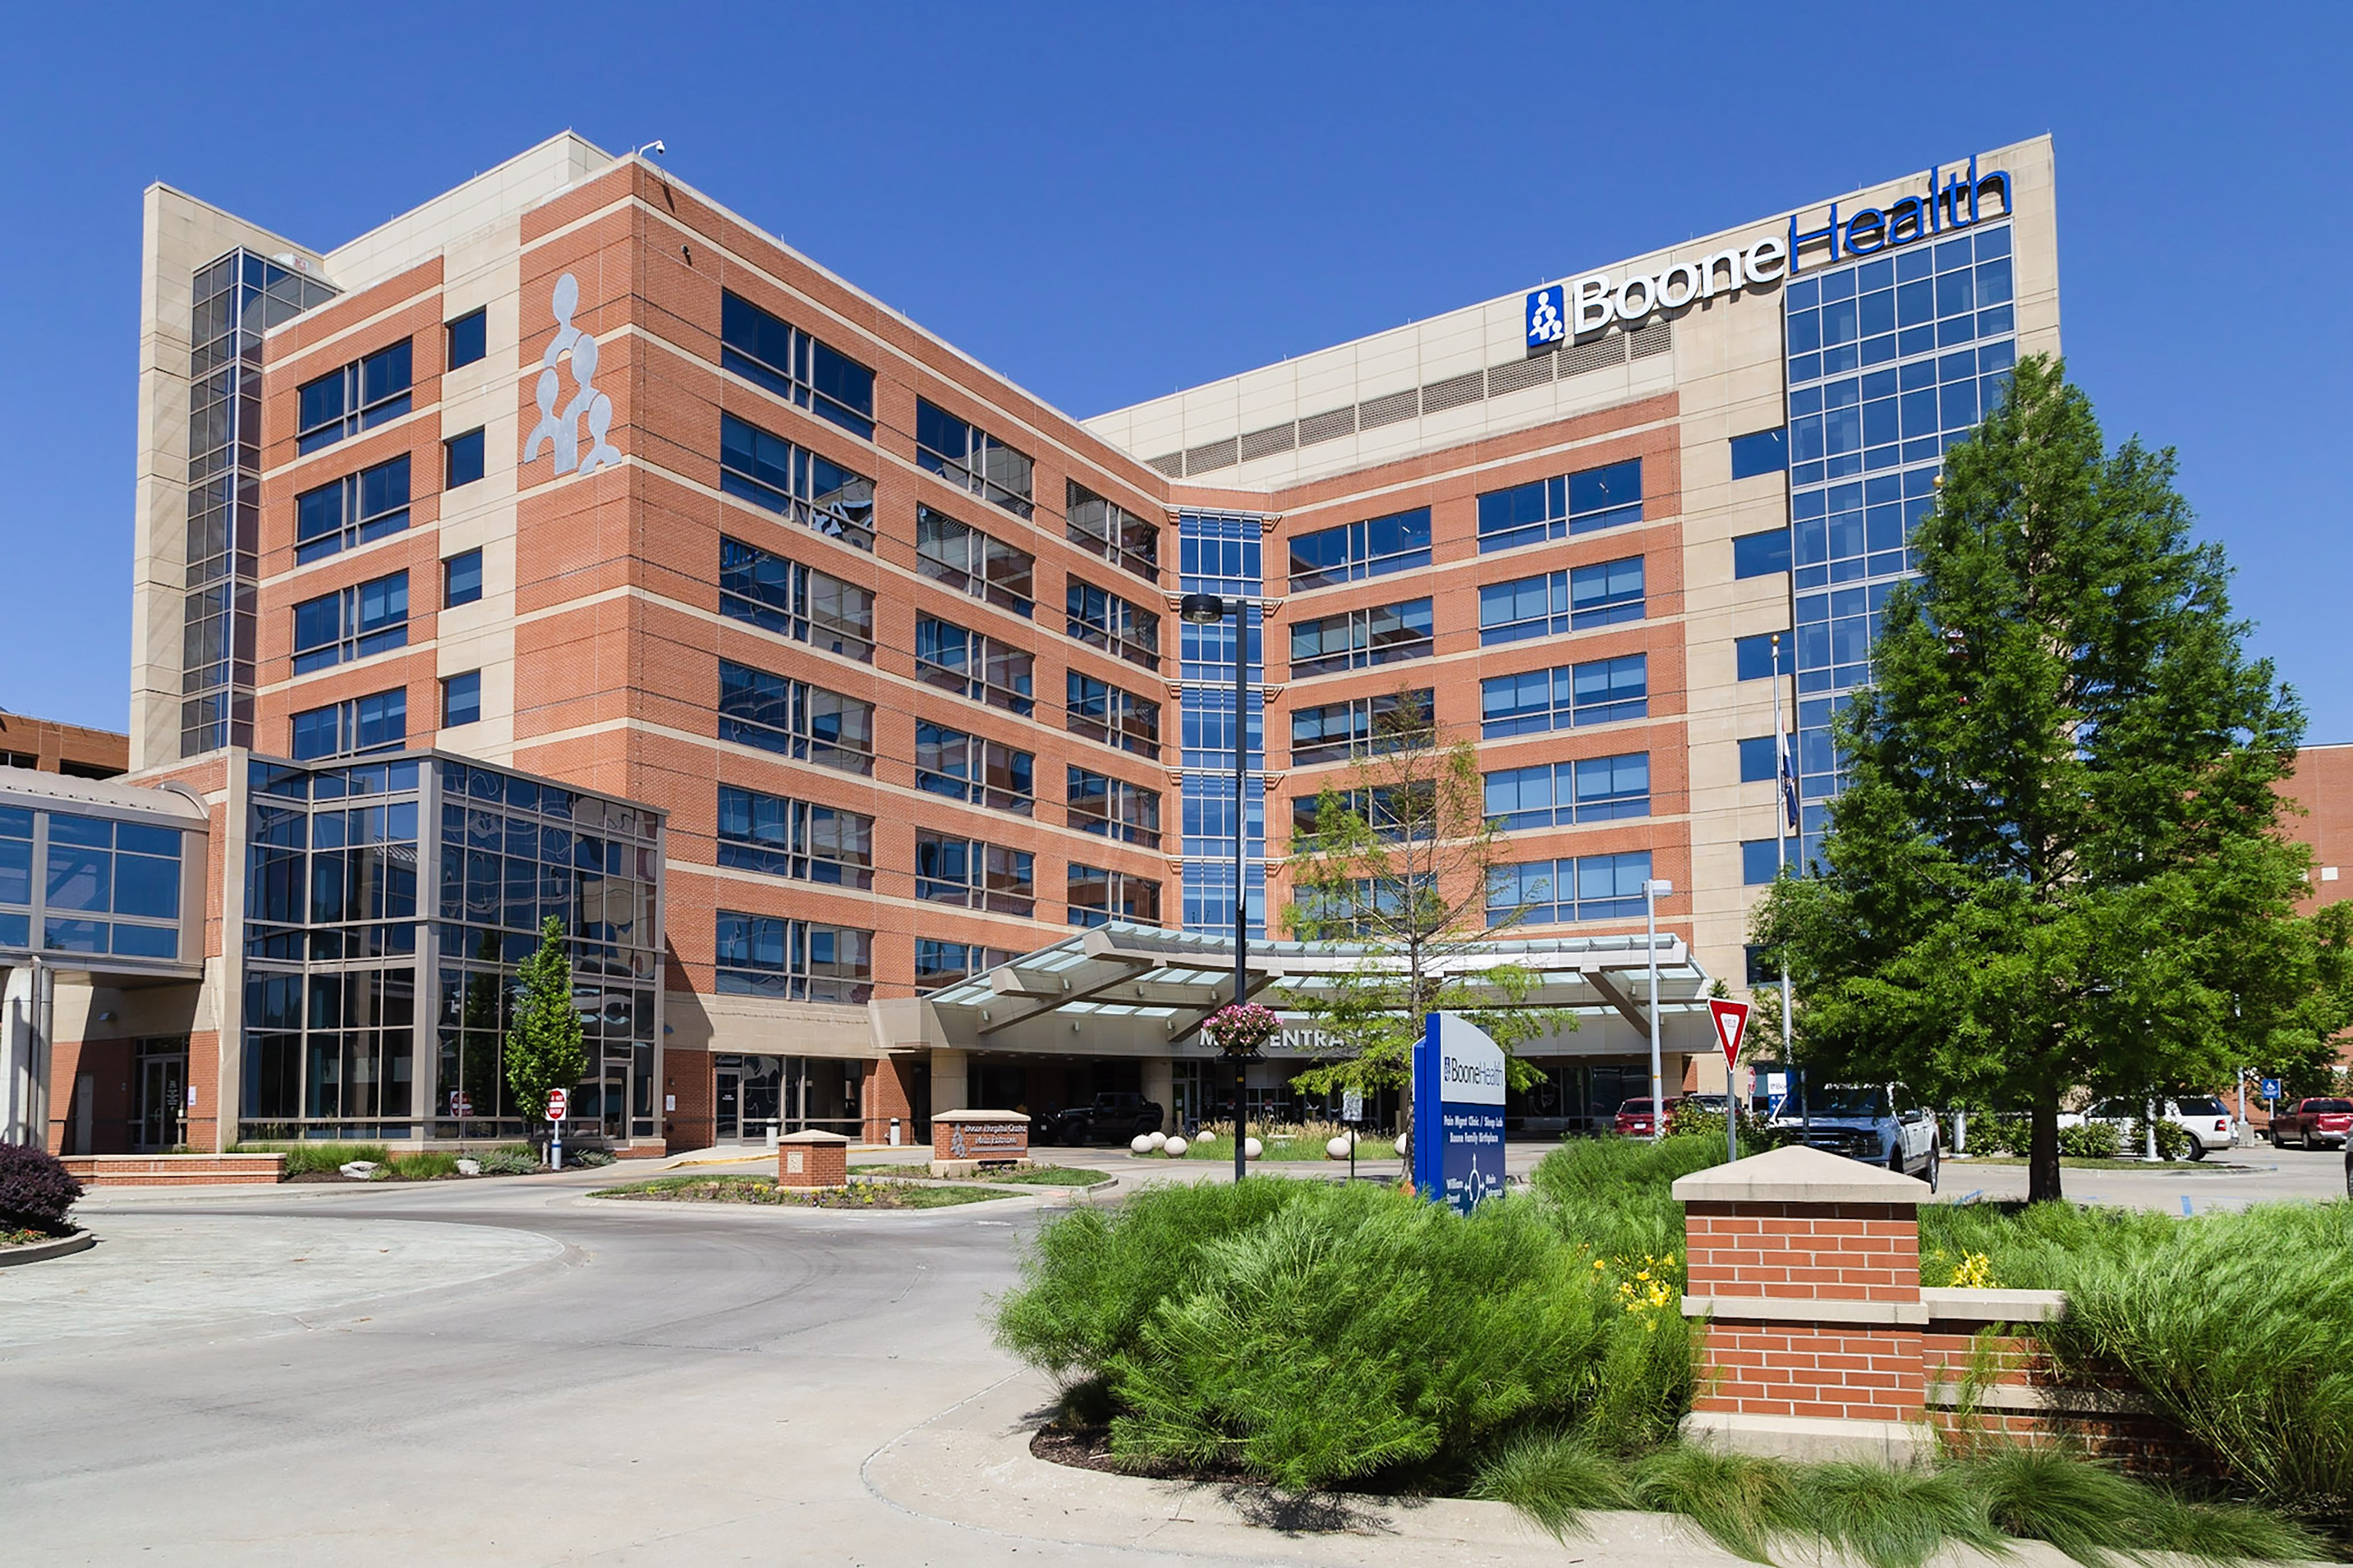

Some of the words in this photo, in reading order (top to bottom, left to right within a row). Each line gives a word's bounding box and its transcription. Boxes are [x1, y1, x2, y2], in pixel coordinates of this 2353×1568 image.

[1572, 154, 2012, 335] BooneHealth
[1451, 1057, 1503, 1086] BooneHealth
[983, 1124, 1008, 1133] Hospital
